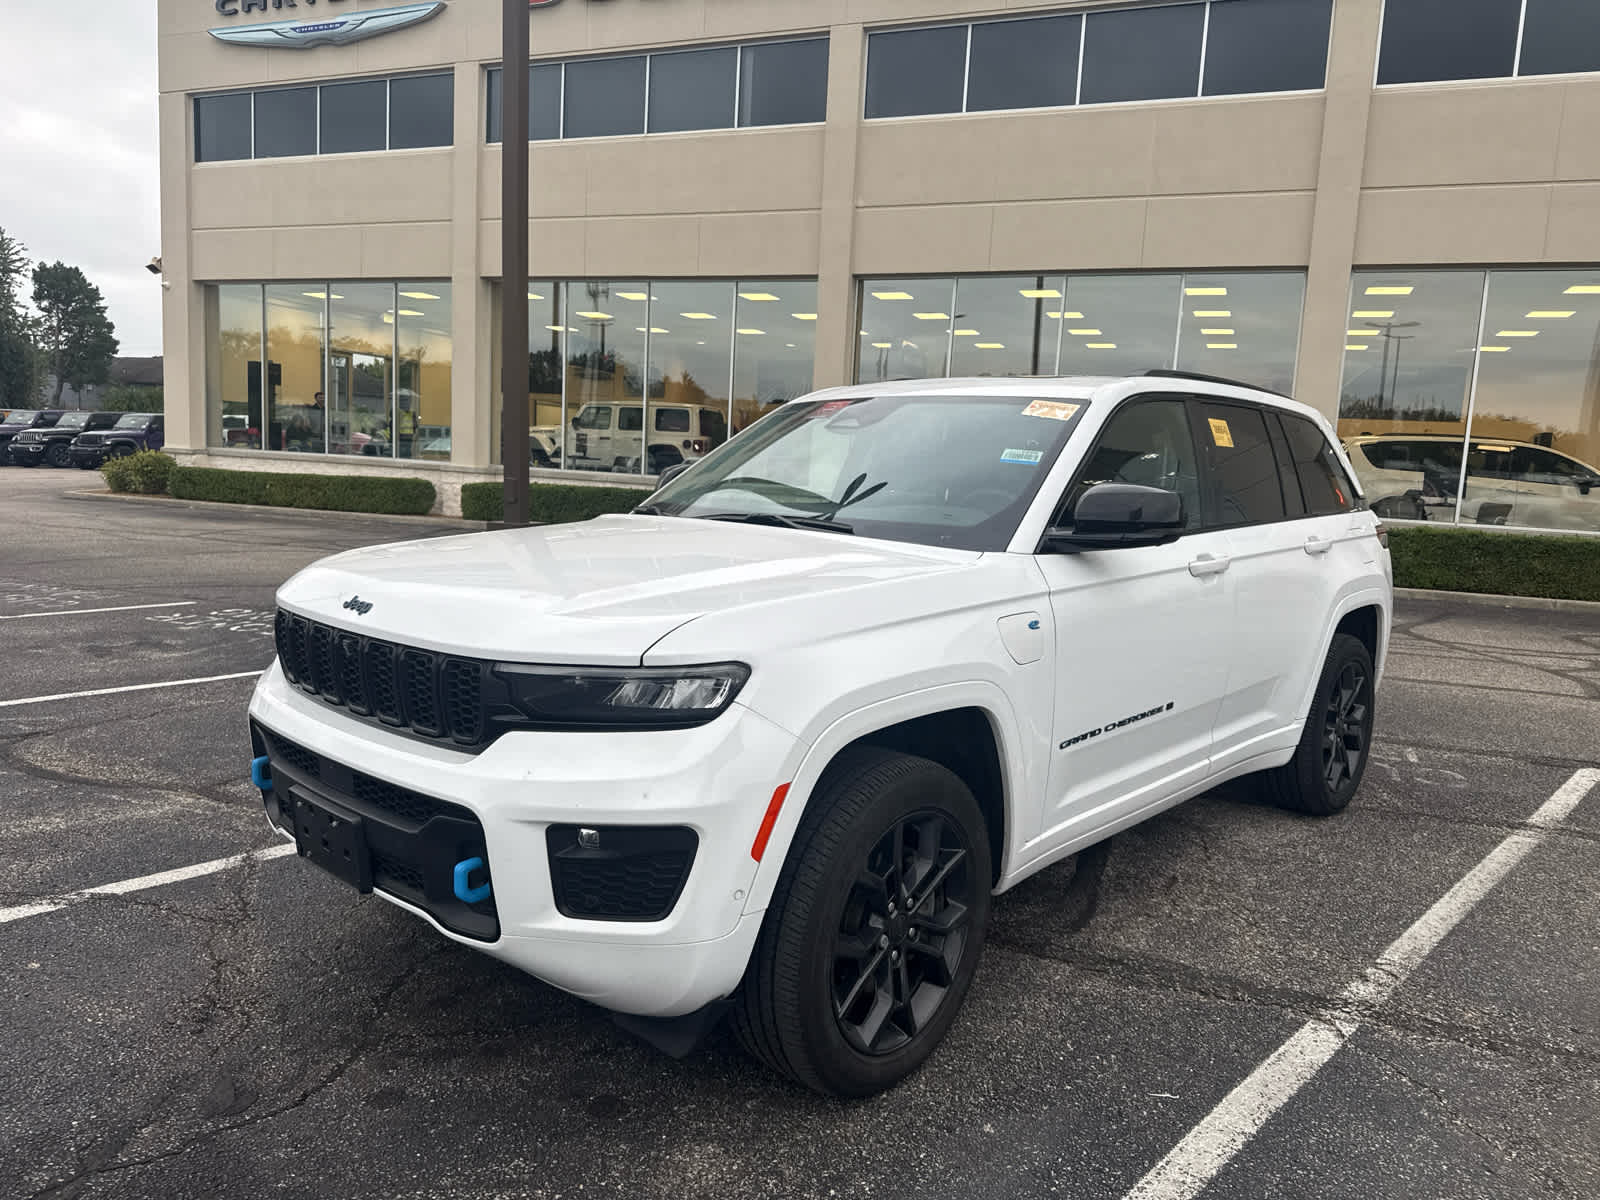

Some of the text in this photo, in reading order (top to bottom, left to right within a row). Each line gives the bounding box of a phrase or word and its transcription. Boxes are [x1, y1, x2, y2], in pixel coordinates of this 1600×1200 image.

[343, 595, 374, 616] Jeep
[1059, 705, 1165, 750] GRAND CHEROKEE
